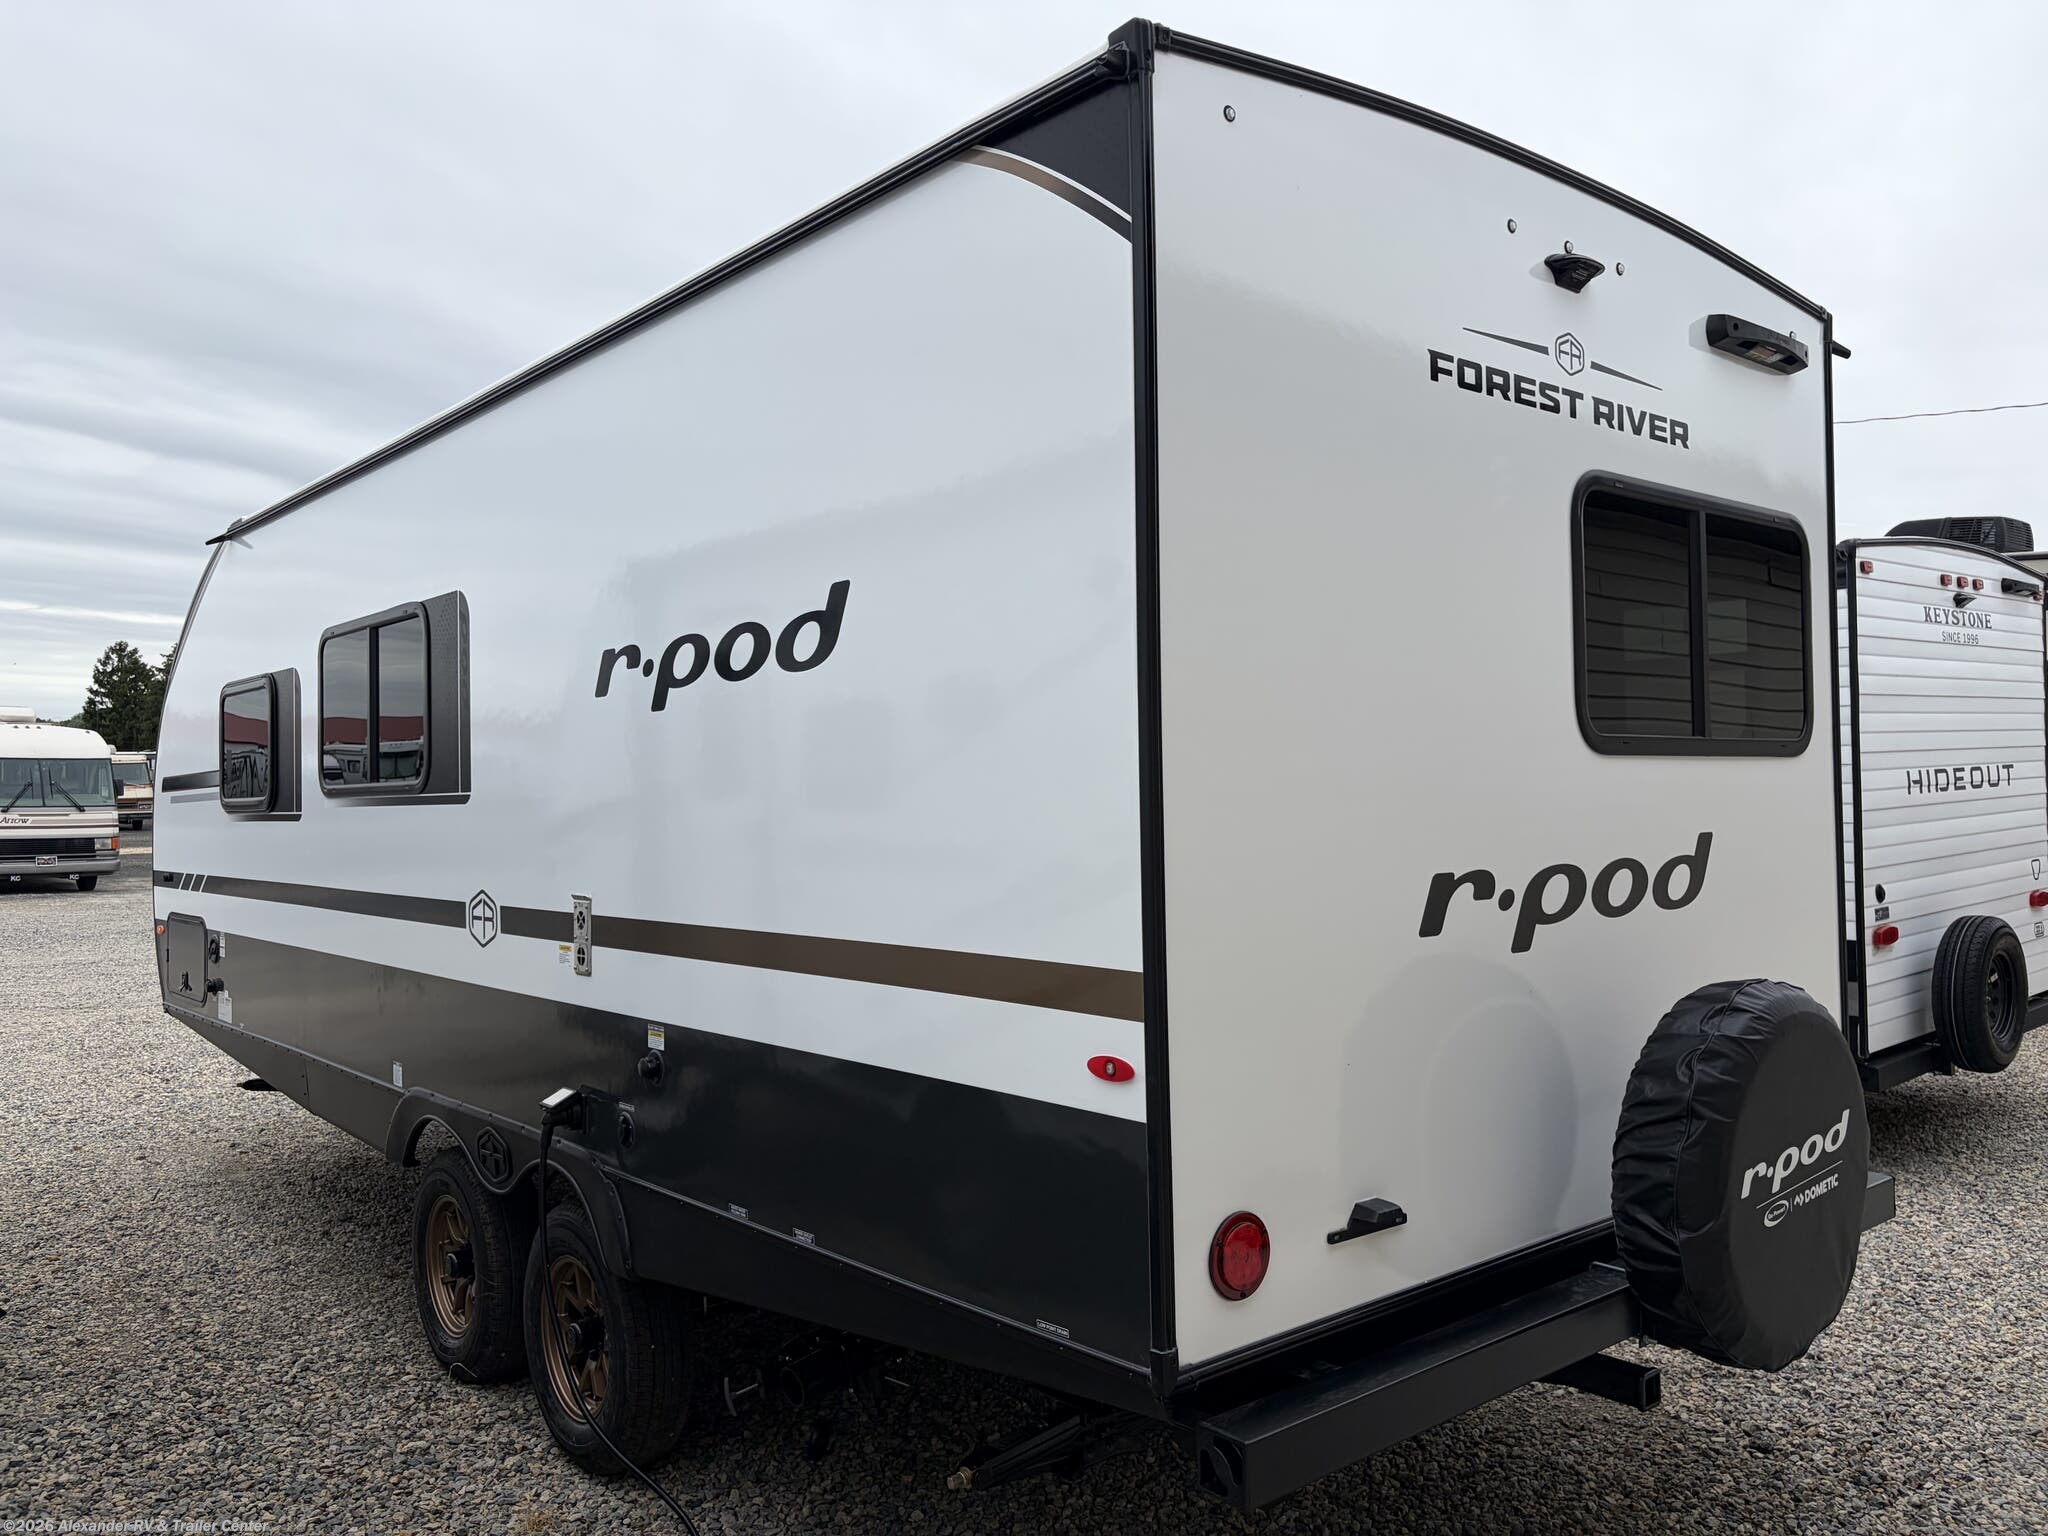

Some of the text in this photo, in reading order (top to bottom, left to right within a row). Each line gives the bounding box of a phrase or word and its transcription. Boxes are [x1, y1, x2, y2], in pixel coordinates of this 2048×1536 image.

[1427, 349, 1690, 450] FOREST RIVER
[1923, 606, 1993, 630] KEYSTONE
[1941, 630, 1979, 645] SINCE 1996
[1906, 764, 2015, 795] HIDEOUT
[1804, 1174, 1839, 1203] DOMETIC
